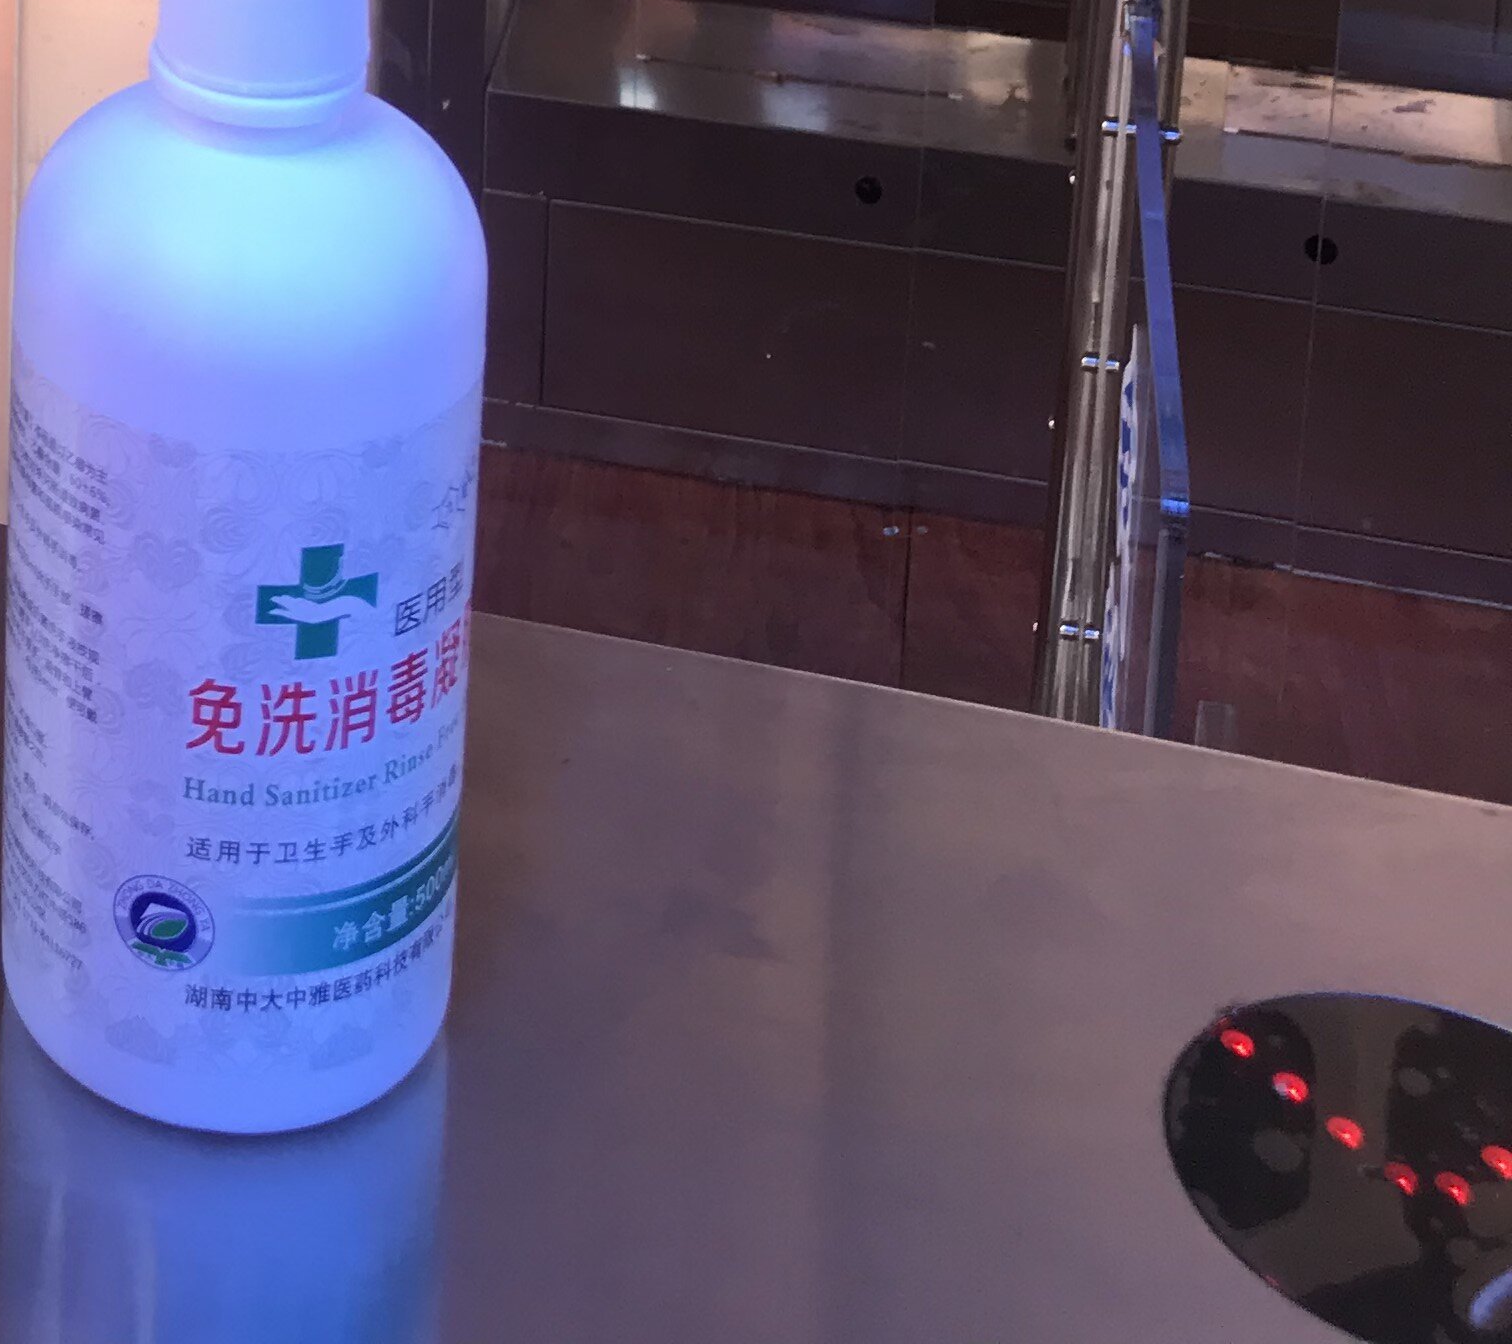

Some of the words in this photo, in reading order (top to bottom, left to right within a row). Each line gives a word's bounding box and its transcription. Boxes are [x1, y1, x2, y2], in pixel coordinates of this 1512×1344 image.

[182, 776, 255, 807] Hand
[265, 773, 377, 807] Sanitizer
[383, 743, 434, 784] Rinse
